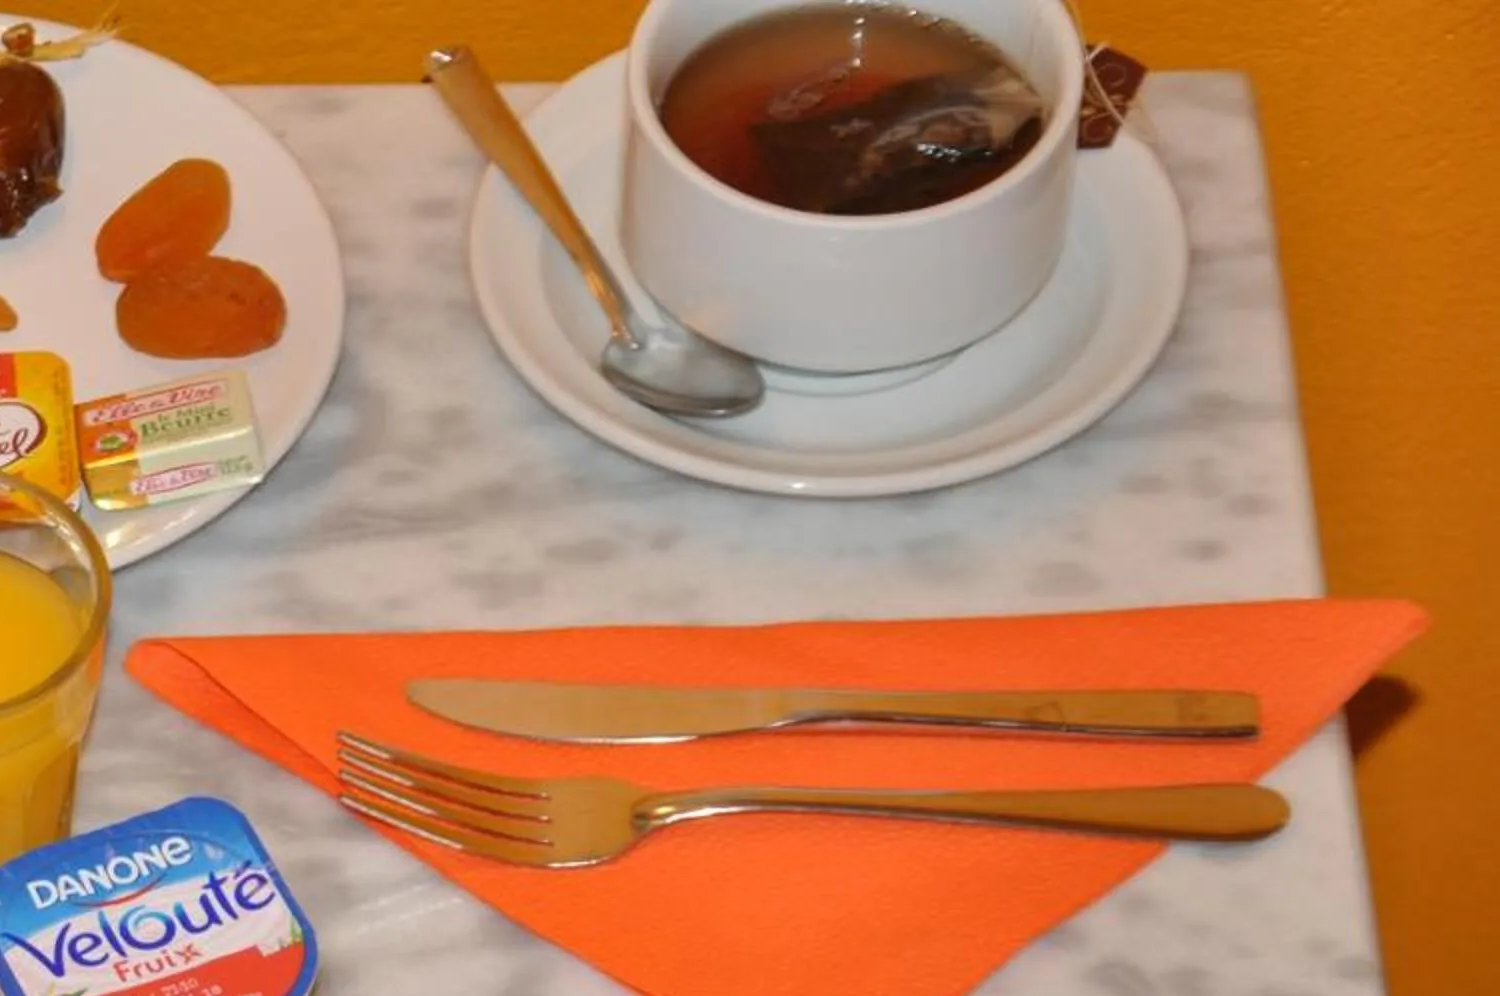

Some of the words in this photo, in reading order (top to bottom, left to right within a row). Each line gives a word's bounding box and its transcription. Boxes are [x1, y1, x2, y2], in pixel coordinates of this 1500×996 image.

[141, 407, 231, 438] Beurre
[1, 860, 276, 978] Velouté
[112, 943, 201, 982] Fruix
